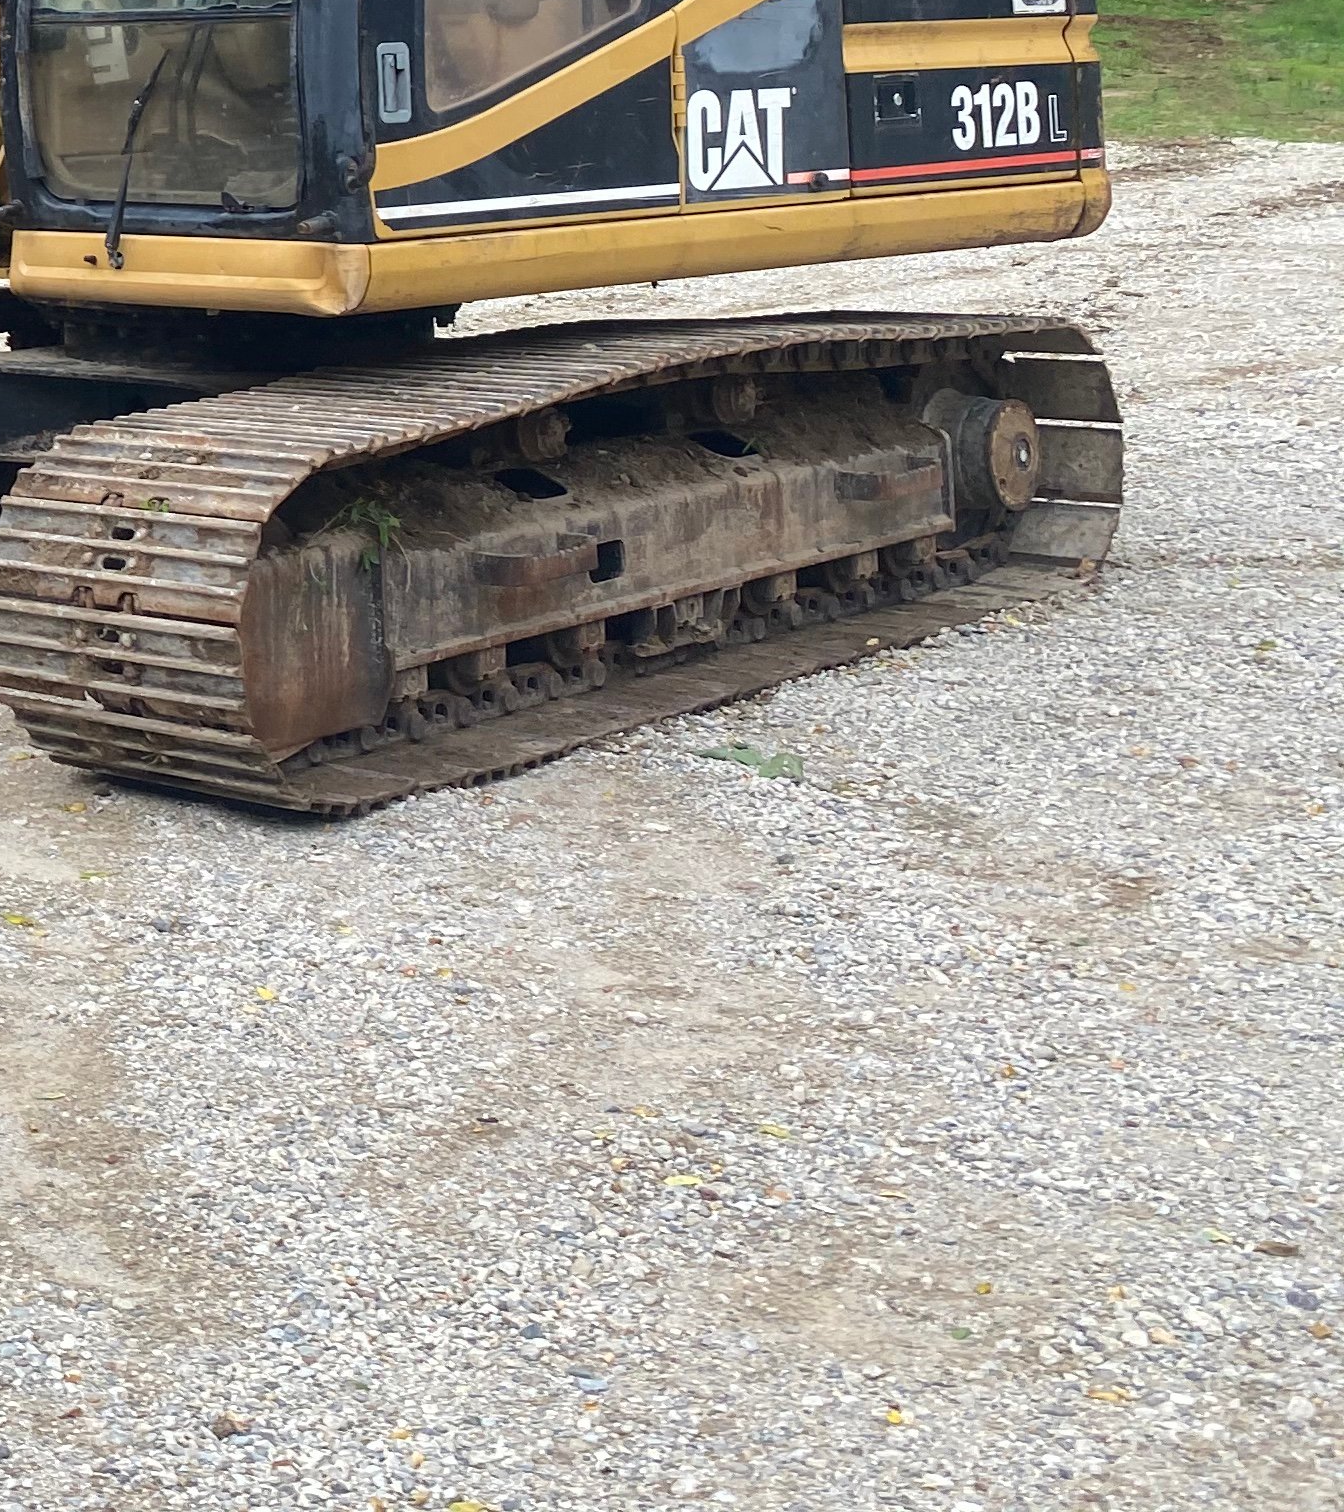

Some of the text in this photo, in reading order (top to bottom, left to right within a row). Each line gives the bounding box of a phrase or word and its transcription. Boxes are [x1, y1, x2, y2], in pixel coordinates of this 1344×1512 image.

[686, 87, 792, 192] CAT
[950, 80, 1068, 151] 312B L
